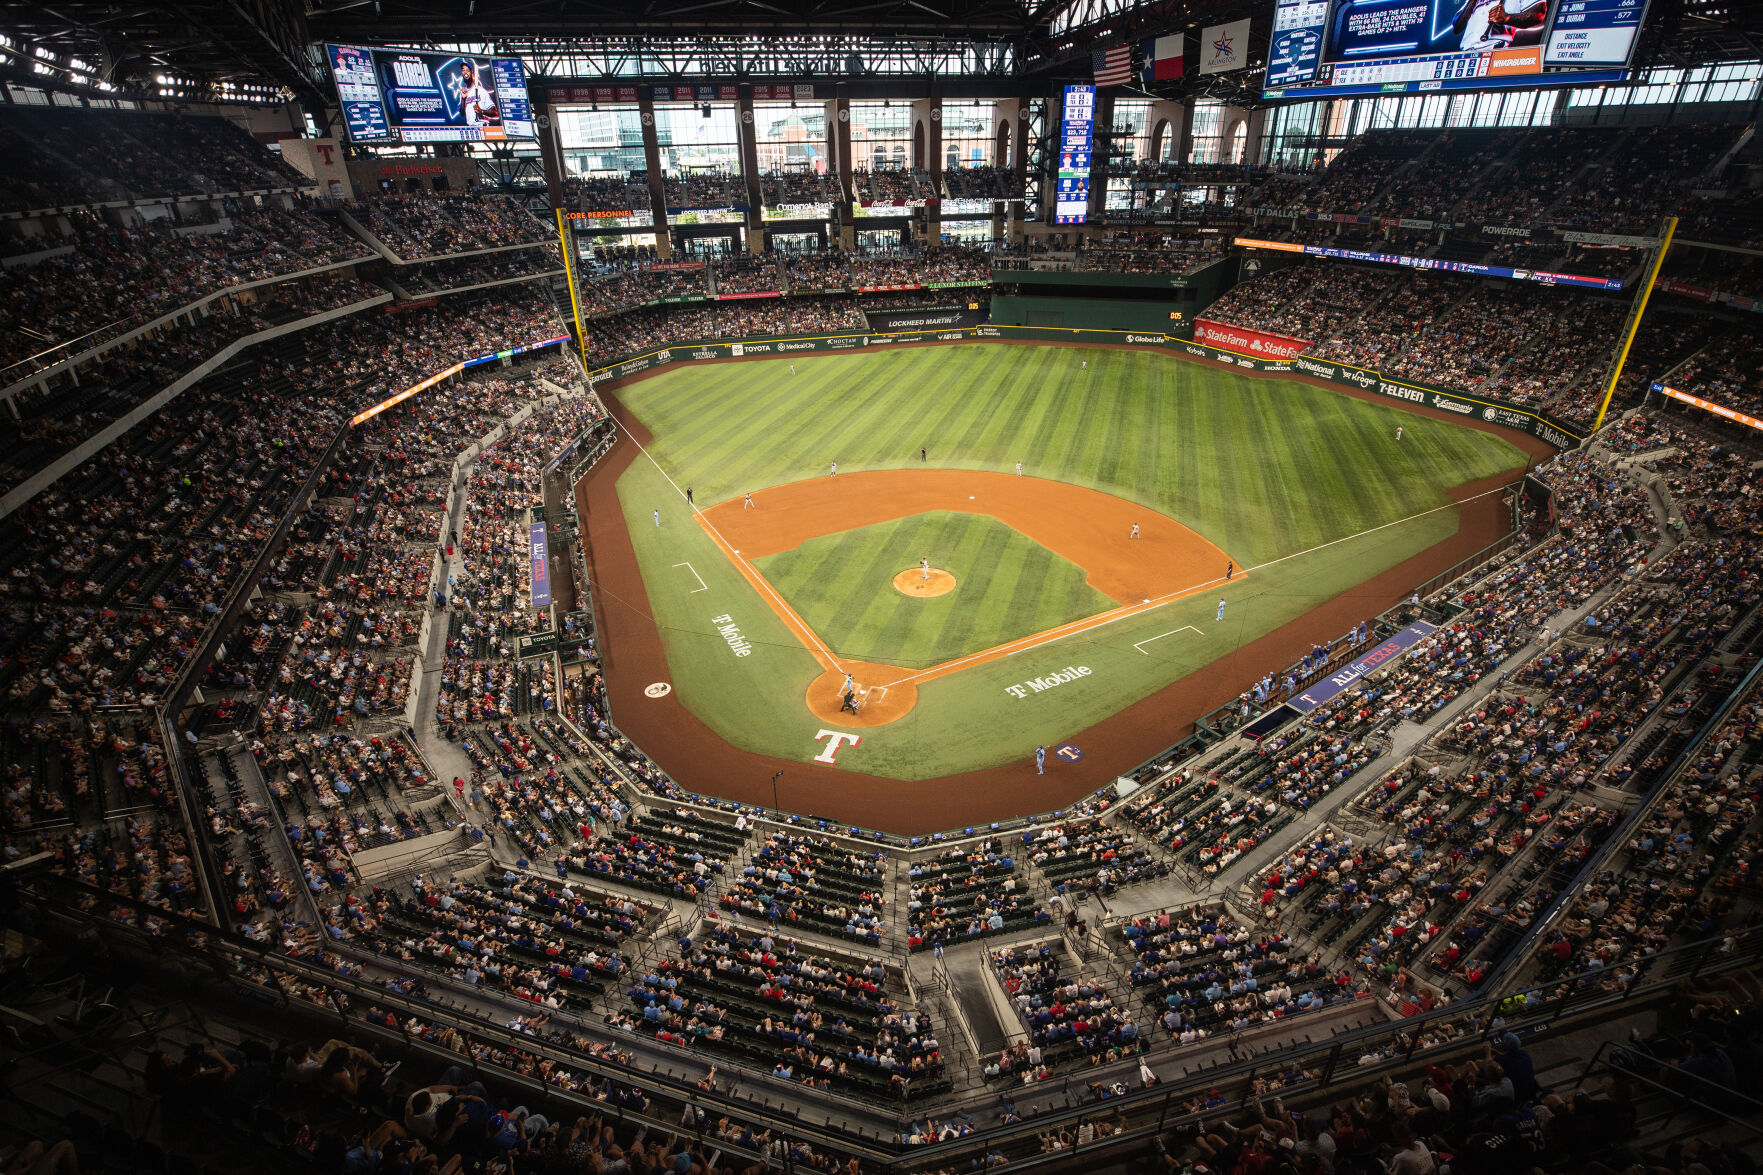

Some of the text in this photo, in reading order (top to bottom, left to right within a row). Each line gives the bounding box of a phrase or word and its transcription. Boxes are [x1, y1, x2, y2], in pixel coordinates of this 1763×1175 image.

[1400, 6, 1427, 14] RANGERS
[1349, 23, 1381, 32] EXTRA-BASE
[1208, 56, 1237, 66] ARLINGTON
[1493, 58, 1536, 68] WHATABURGER
[643, 114, 652, 124] 34
[743, 112, 753, 122] 26
[842, 110, 847, 120] 7
[932, 110, 941, 119] 29
[1020, 110, 1028, 119] 10
[539, 117, 548, 126] 42
[316, 145, 334, 166] T
[395, 164, 442, 175] Budweiser
[872, 200, 893, 208] Coca-Cola
[905, 199, 926, 207] Coca-Cola
[587, 210, 633, 218] PERSONNEL
[1268, 209, 1299, 218] DALLAS
[1482, 226, 1531, 237] POWERADE
[658, 350, 671, 360] UTA
[1186, 346, 1206, 357] Kubota
[1305, 361, 1335, 374] National
[1351, 371, 1376, 388] Kroger
[1379, 382, 1424, 404] 7-ELEVEN
[1442, 400, 1473, 410] Germania
[1543, 427, 1569, 450] Mobile
[534, 543, 545, 582] ALL TEXAS
[532, 634, 556, 643] TOYOTA
[717, 624, 751, 658] Mobile
[1332, 669, 1360, 687] ALL
[1363, 643, 1401, 667] TEXAS
[1028, 664, 1092, 694] Mobile
[1300, 694, 1318, 705] T
[814, 728, 862, 766] T
[1057, 745, 1080, 759] T
